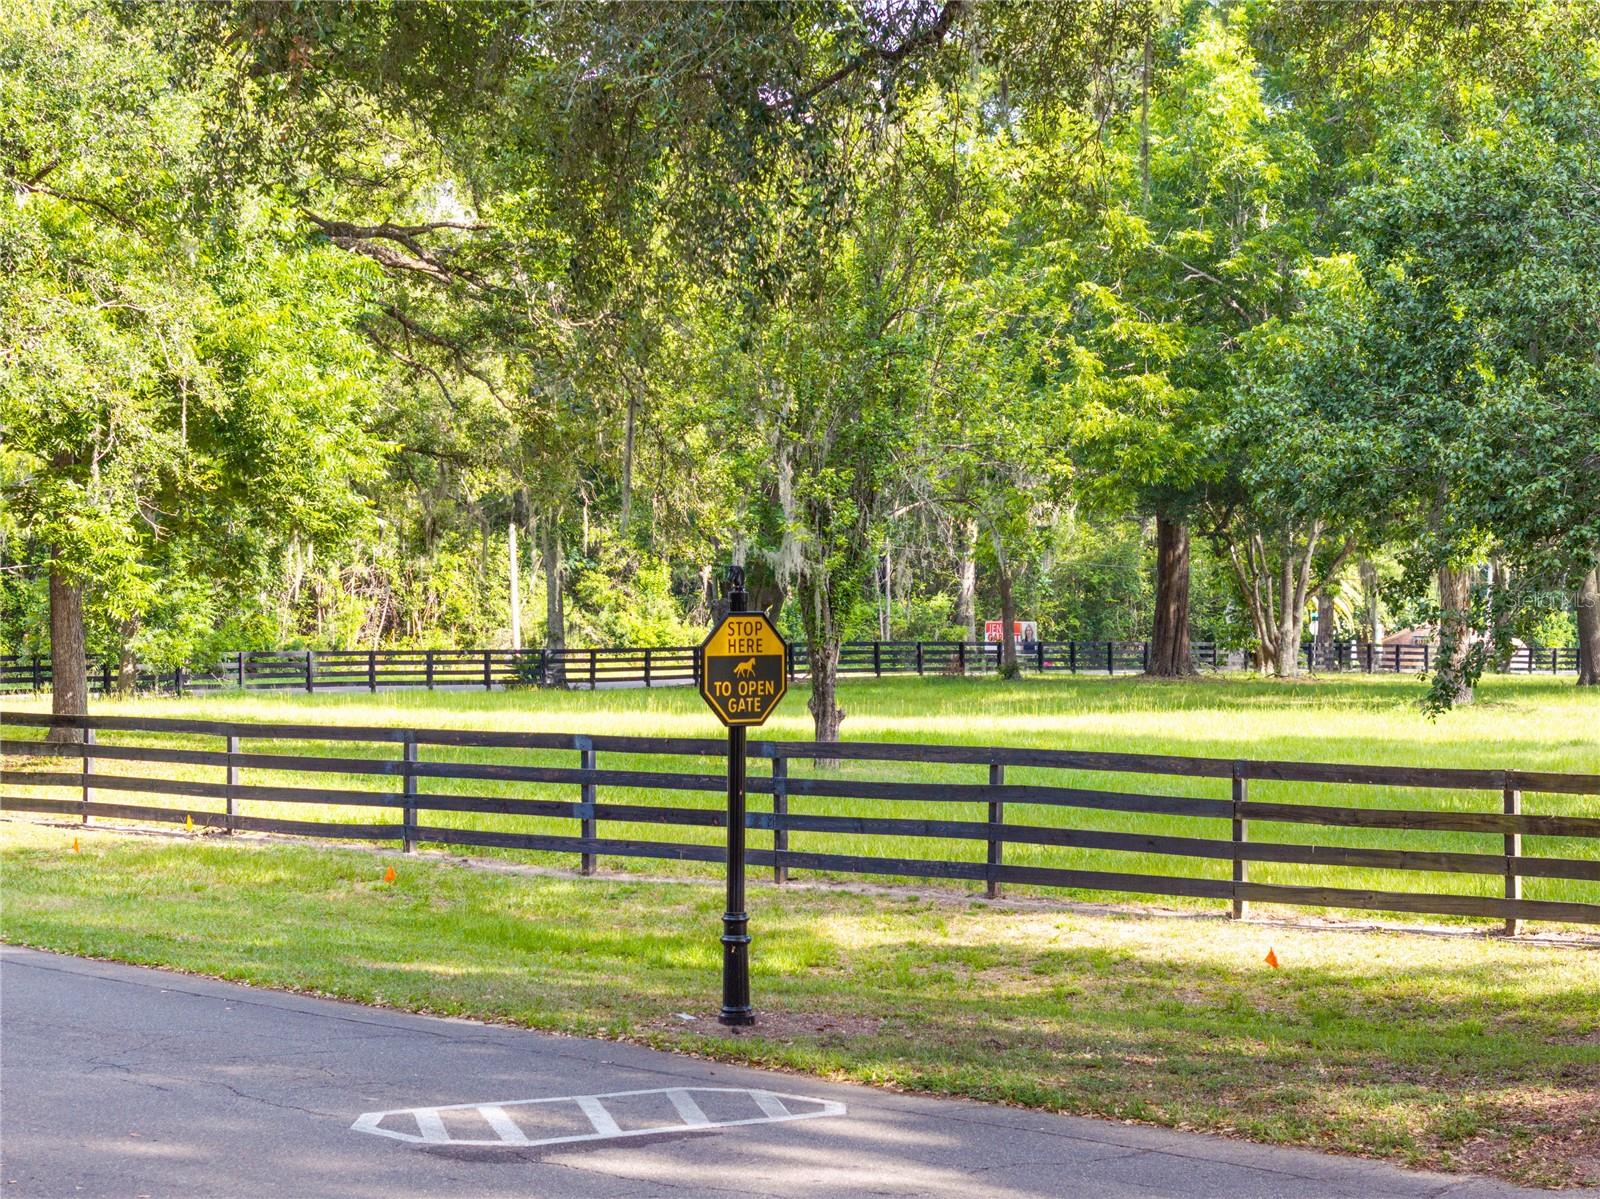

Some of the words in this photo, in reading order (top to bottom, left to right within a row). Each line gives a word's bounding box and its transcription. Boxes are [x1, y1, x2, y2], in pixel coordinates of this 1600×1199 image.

[728, 621, 763, 636] STOP
[728, 638, 763, 653] HERE
[714, 681, 732, 697] TO
[738, 680, 775, 696] OPEN
[728, 697, 761, 713] GATE
